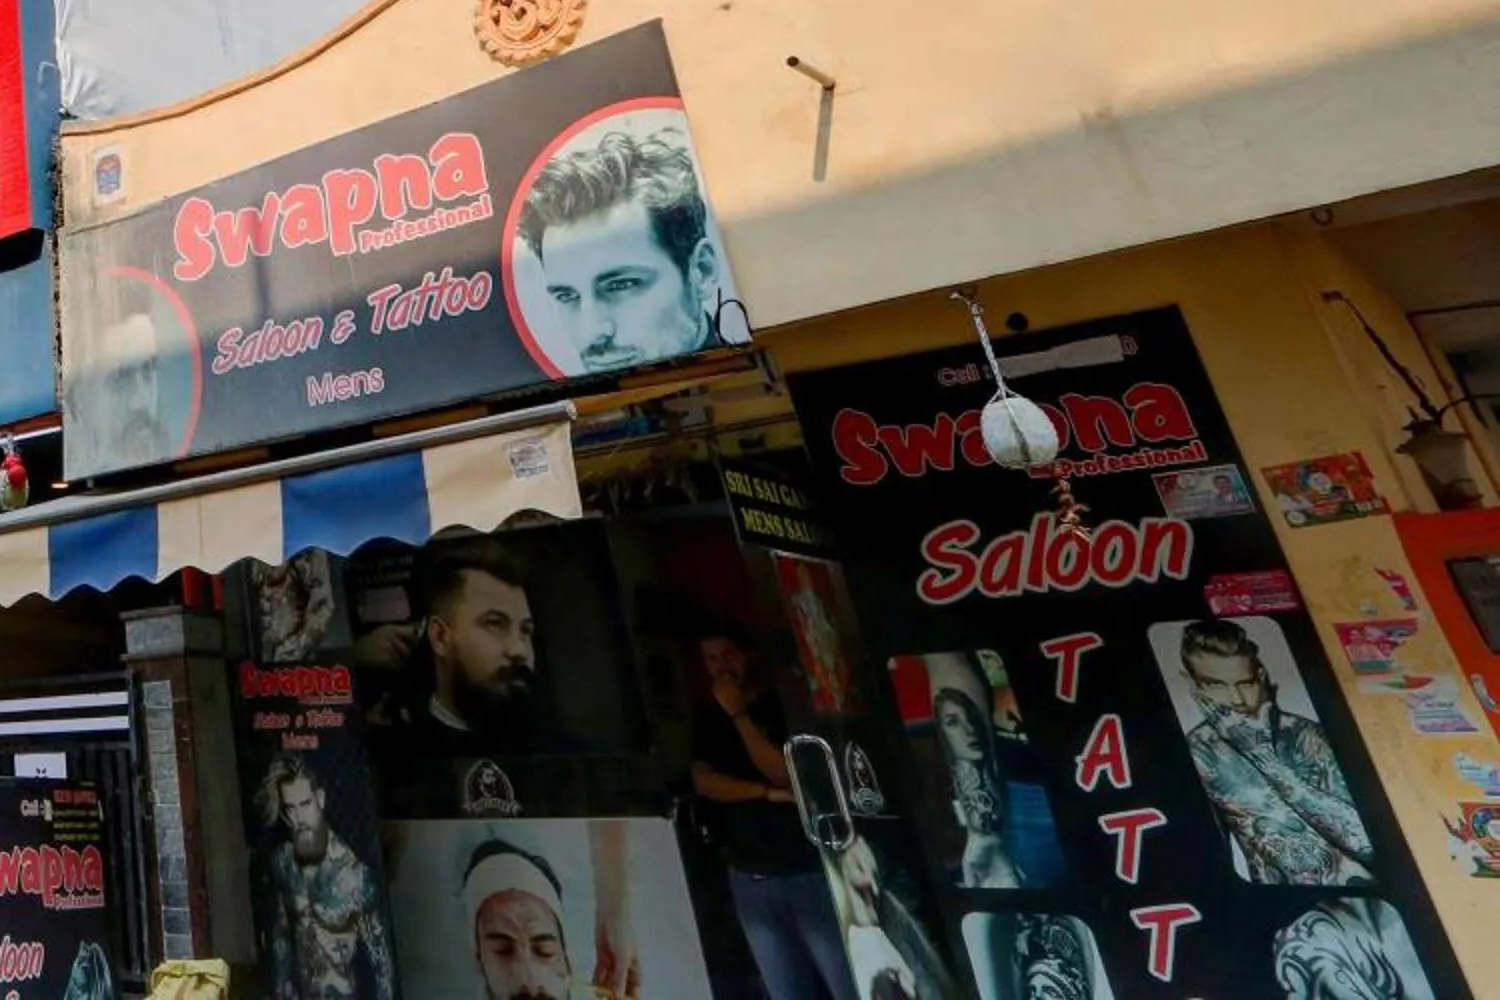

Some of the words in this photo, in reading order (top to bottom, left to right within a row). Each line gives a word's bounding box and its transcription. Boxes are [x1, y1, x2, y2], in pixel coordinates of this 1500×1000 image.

[173, 132, 489, 281] Swapna
[358, 193, 494, 255] Professional
[211, 315, 324, 375] Saloon
[330, 309, 357, 345] &
[367, 267, 493, 334] Tattoo
[306, 367, 385, 407] Mens
[832, 382, 1199, 485] Swana
[1058, 440, 1209, 479] Professional
[740, 507, 784, 537] MENS
[916, 511, 1195, 604] Saloon
